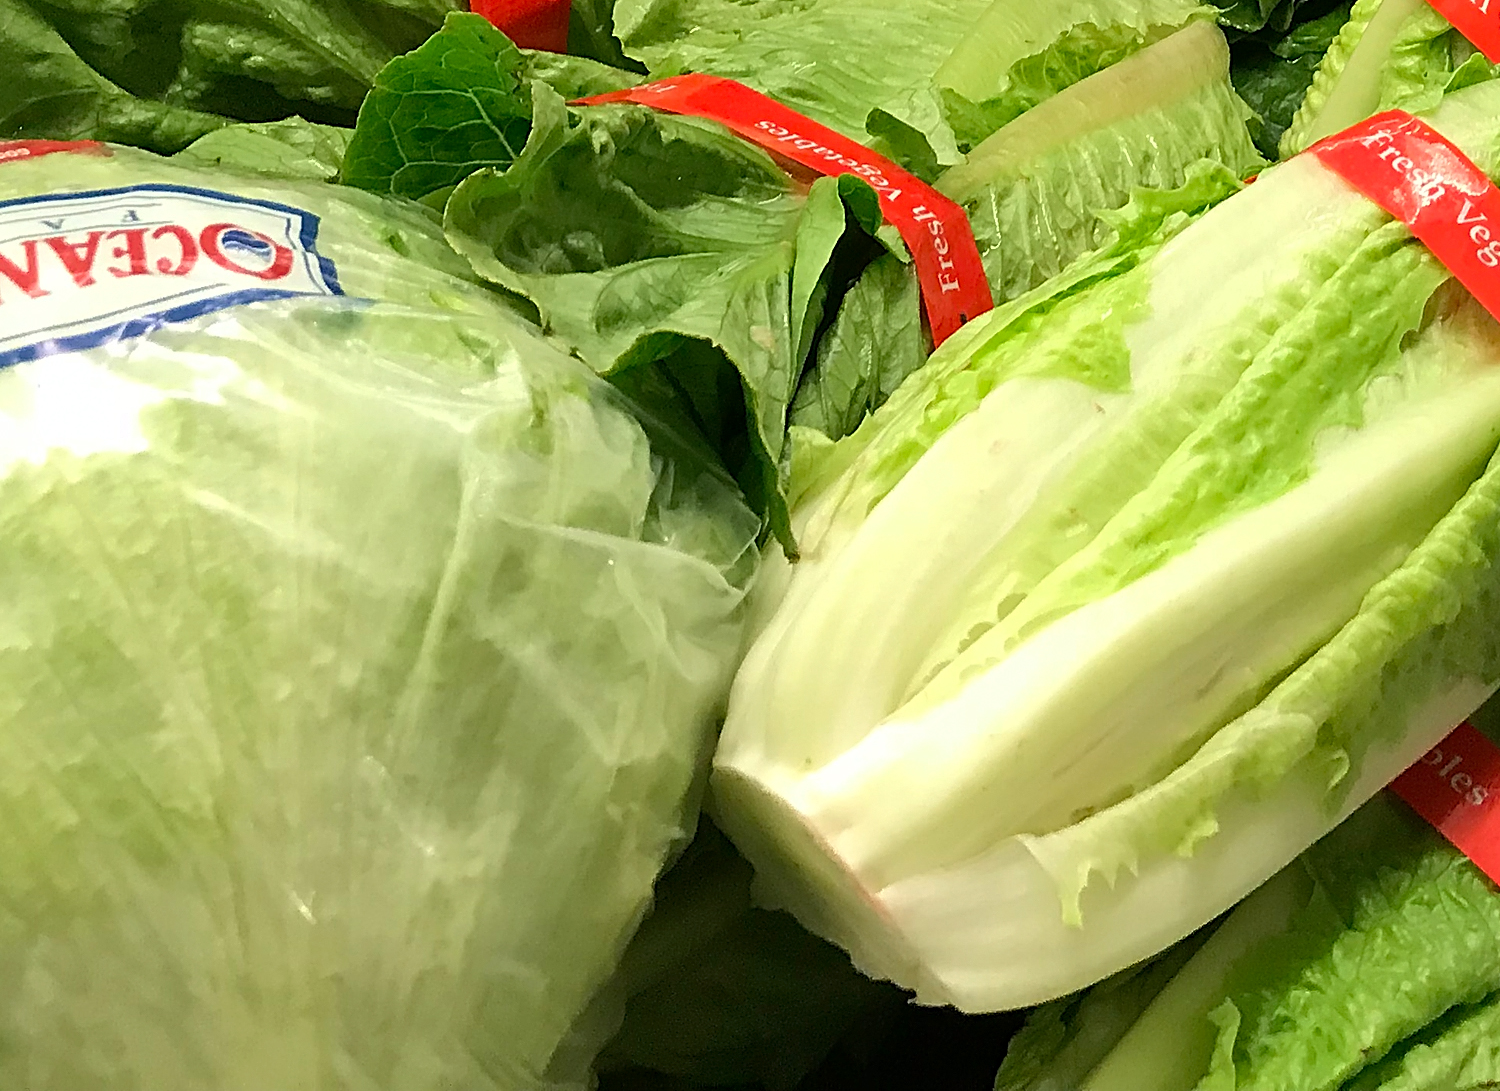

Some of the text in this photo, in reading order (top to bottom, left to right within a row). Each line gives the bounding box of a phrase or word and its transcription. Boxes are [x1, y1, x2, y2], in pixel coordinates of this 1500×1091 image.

[754, 117, 962, 295] Fresh Vegetables
[1361, 128, 1446, 208] Fresh
